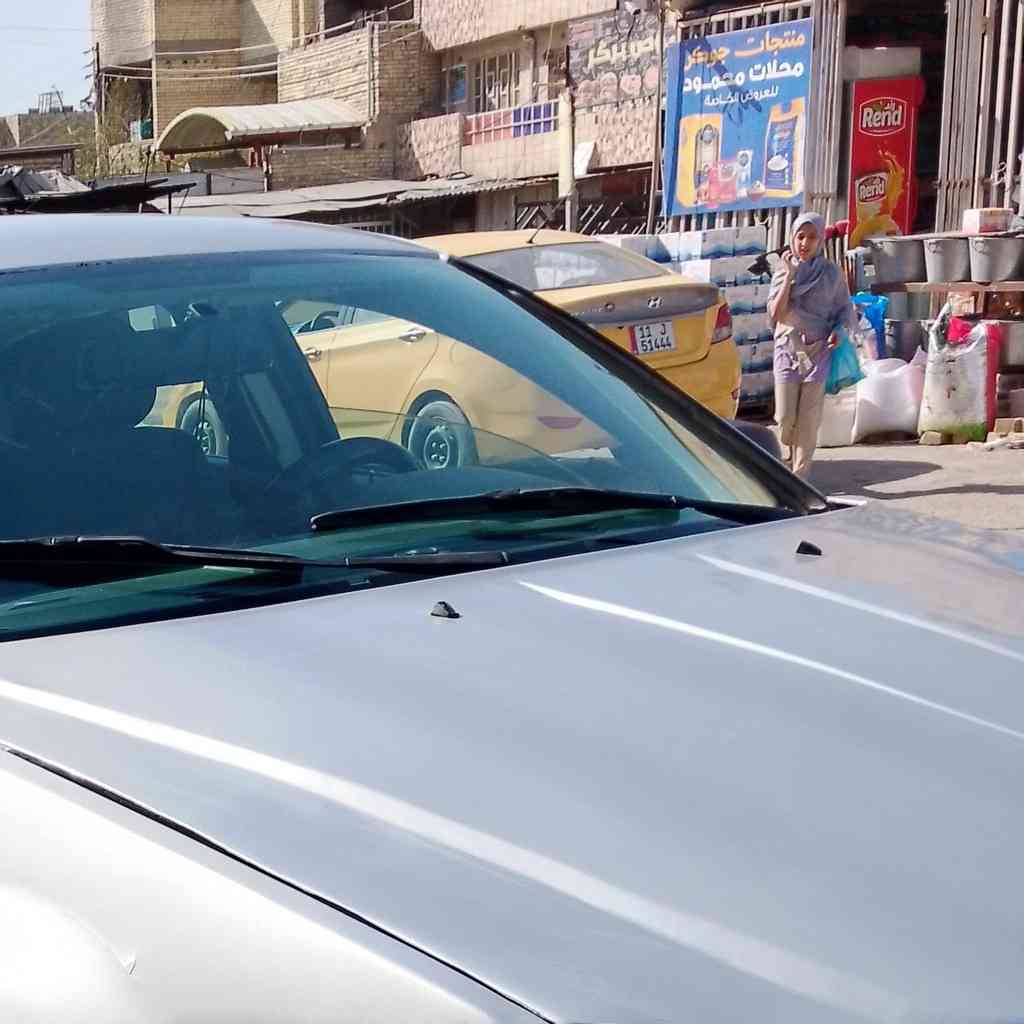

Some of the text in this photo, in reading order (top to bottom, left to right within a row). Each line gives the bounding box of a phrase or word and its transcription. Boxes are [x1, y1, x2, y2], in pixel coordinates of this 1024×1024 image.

[734, 28, 806, 59] منتجات
[682, 58, 805, 94] محلات محمود
[740, 86, 779, 104] للعروض
[862, 104, 903, 128] Rend
[859, 179, 885, 199] Rend
[639, 325, 652, 338] 11
[640, 336, 672, 352] 51444
